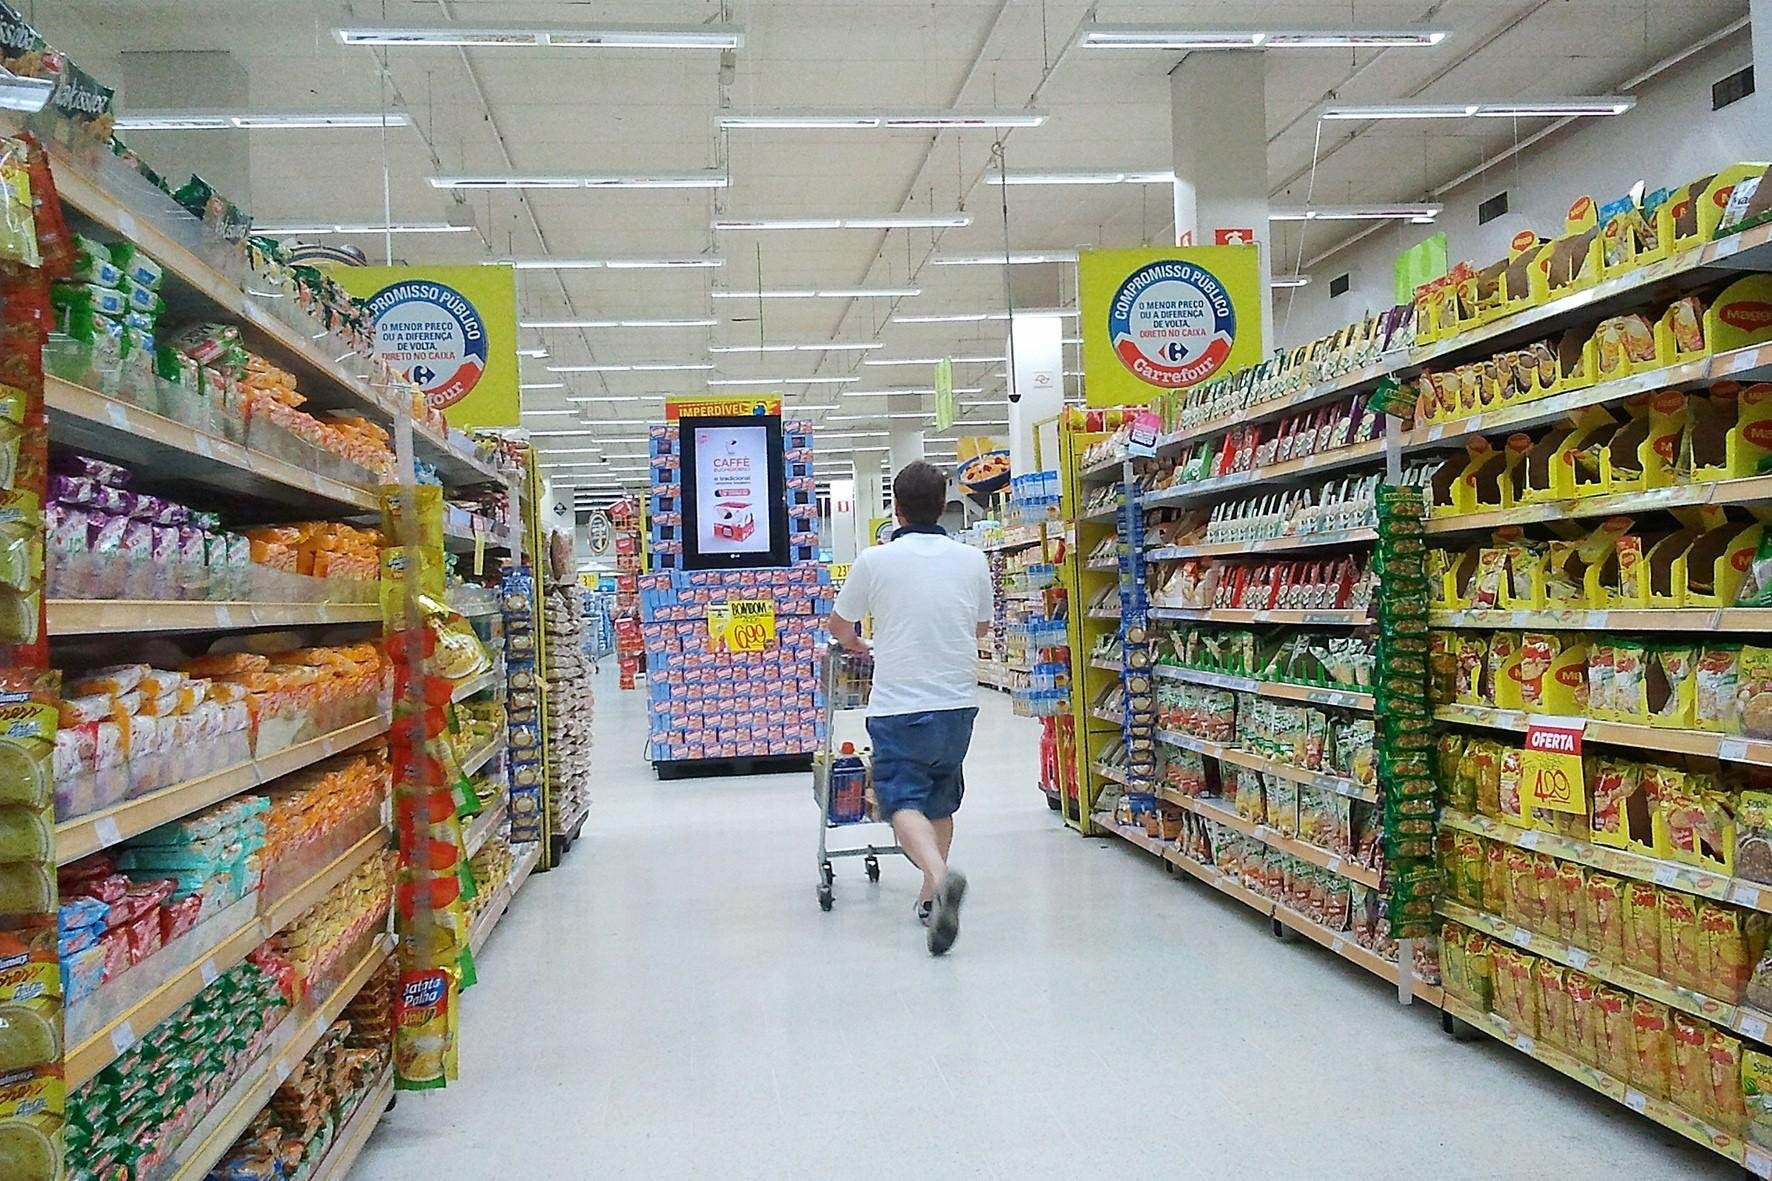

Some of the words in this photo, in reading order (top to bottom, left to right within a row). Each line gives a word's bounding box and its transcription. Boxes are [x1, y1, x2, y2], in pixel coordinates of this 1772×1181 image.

[1115, 264, 1190, 320] COMPROMISSO
[1191, 271, 1229, 318] PÚBLICO
[372, 285, 438, 316] PROMISSO
[440, 293, 481, 340] PÚBLICO
[1146, 300, 1176, 309] MENOR
[1178, 300, 1204, 310] PREÇO
[1160, 310, 1204, 320] DIFERENÇA
[382, 324, 387, 332] O
[390, 322, 422, 331] MENOR
[424, 322, 453, 332] PREÇO
[1140, 330, 1166, 338] DIRETO
[405, 332, 452, 342] DIFERENÇA
[429, 352, 455, 360] CAIXA
[1132, 356, 1215, 384] Carrefour
[679, 403, 744, 418] IMPERDÍVEL
[1532, 732, 1574, 751] OFERTA
[403, 978, 441, 996] Batata
[404, 991, 438, 1008] Palha
